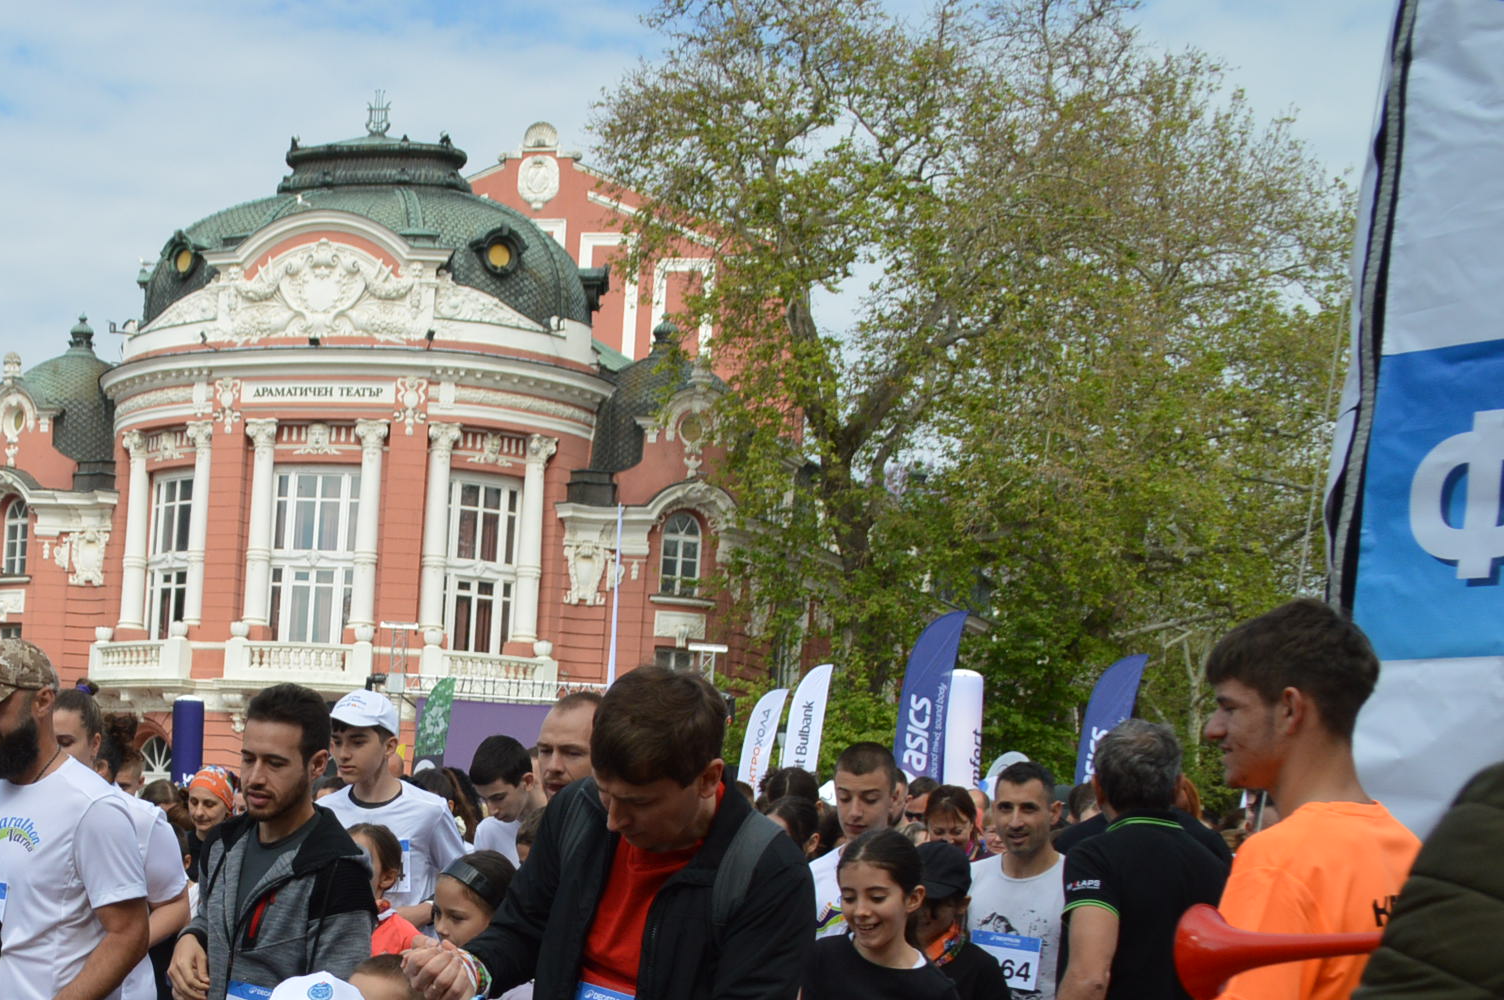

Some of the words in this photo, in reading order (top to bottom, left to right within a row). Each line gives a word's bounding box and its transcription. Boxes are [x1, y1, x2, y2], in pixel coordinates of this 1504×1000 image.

[253, 384, 333, 398] ДРАМАТИЧЕН
[338, 385, 384, 399] ТЕАТЪР
[796, 700, 815, 756] Bulbank
